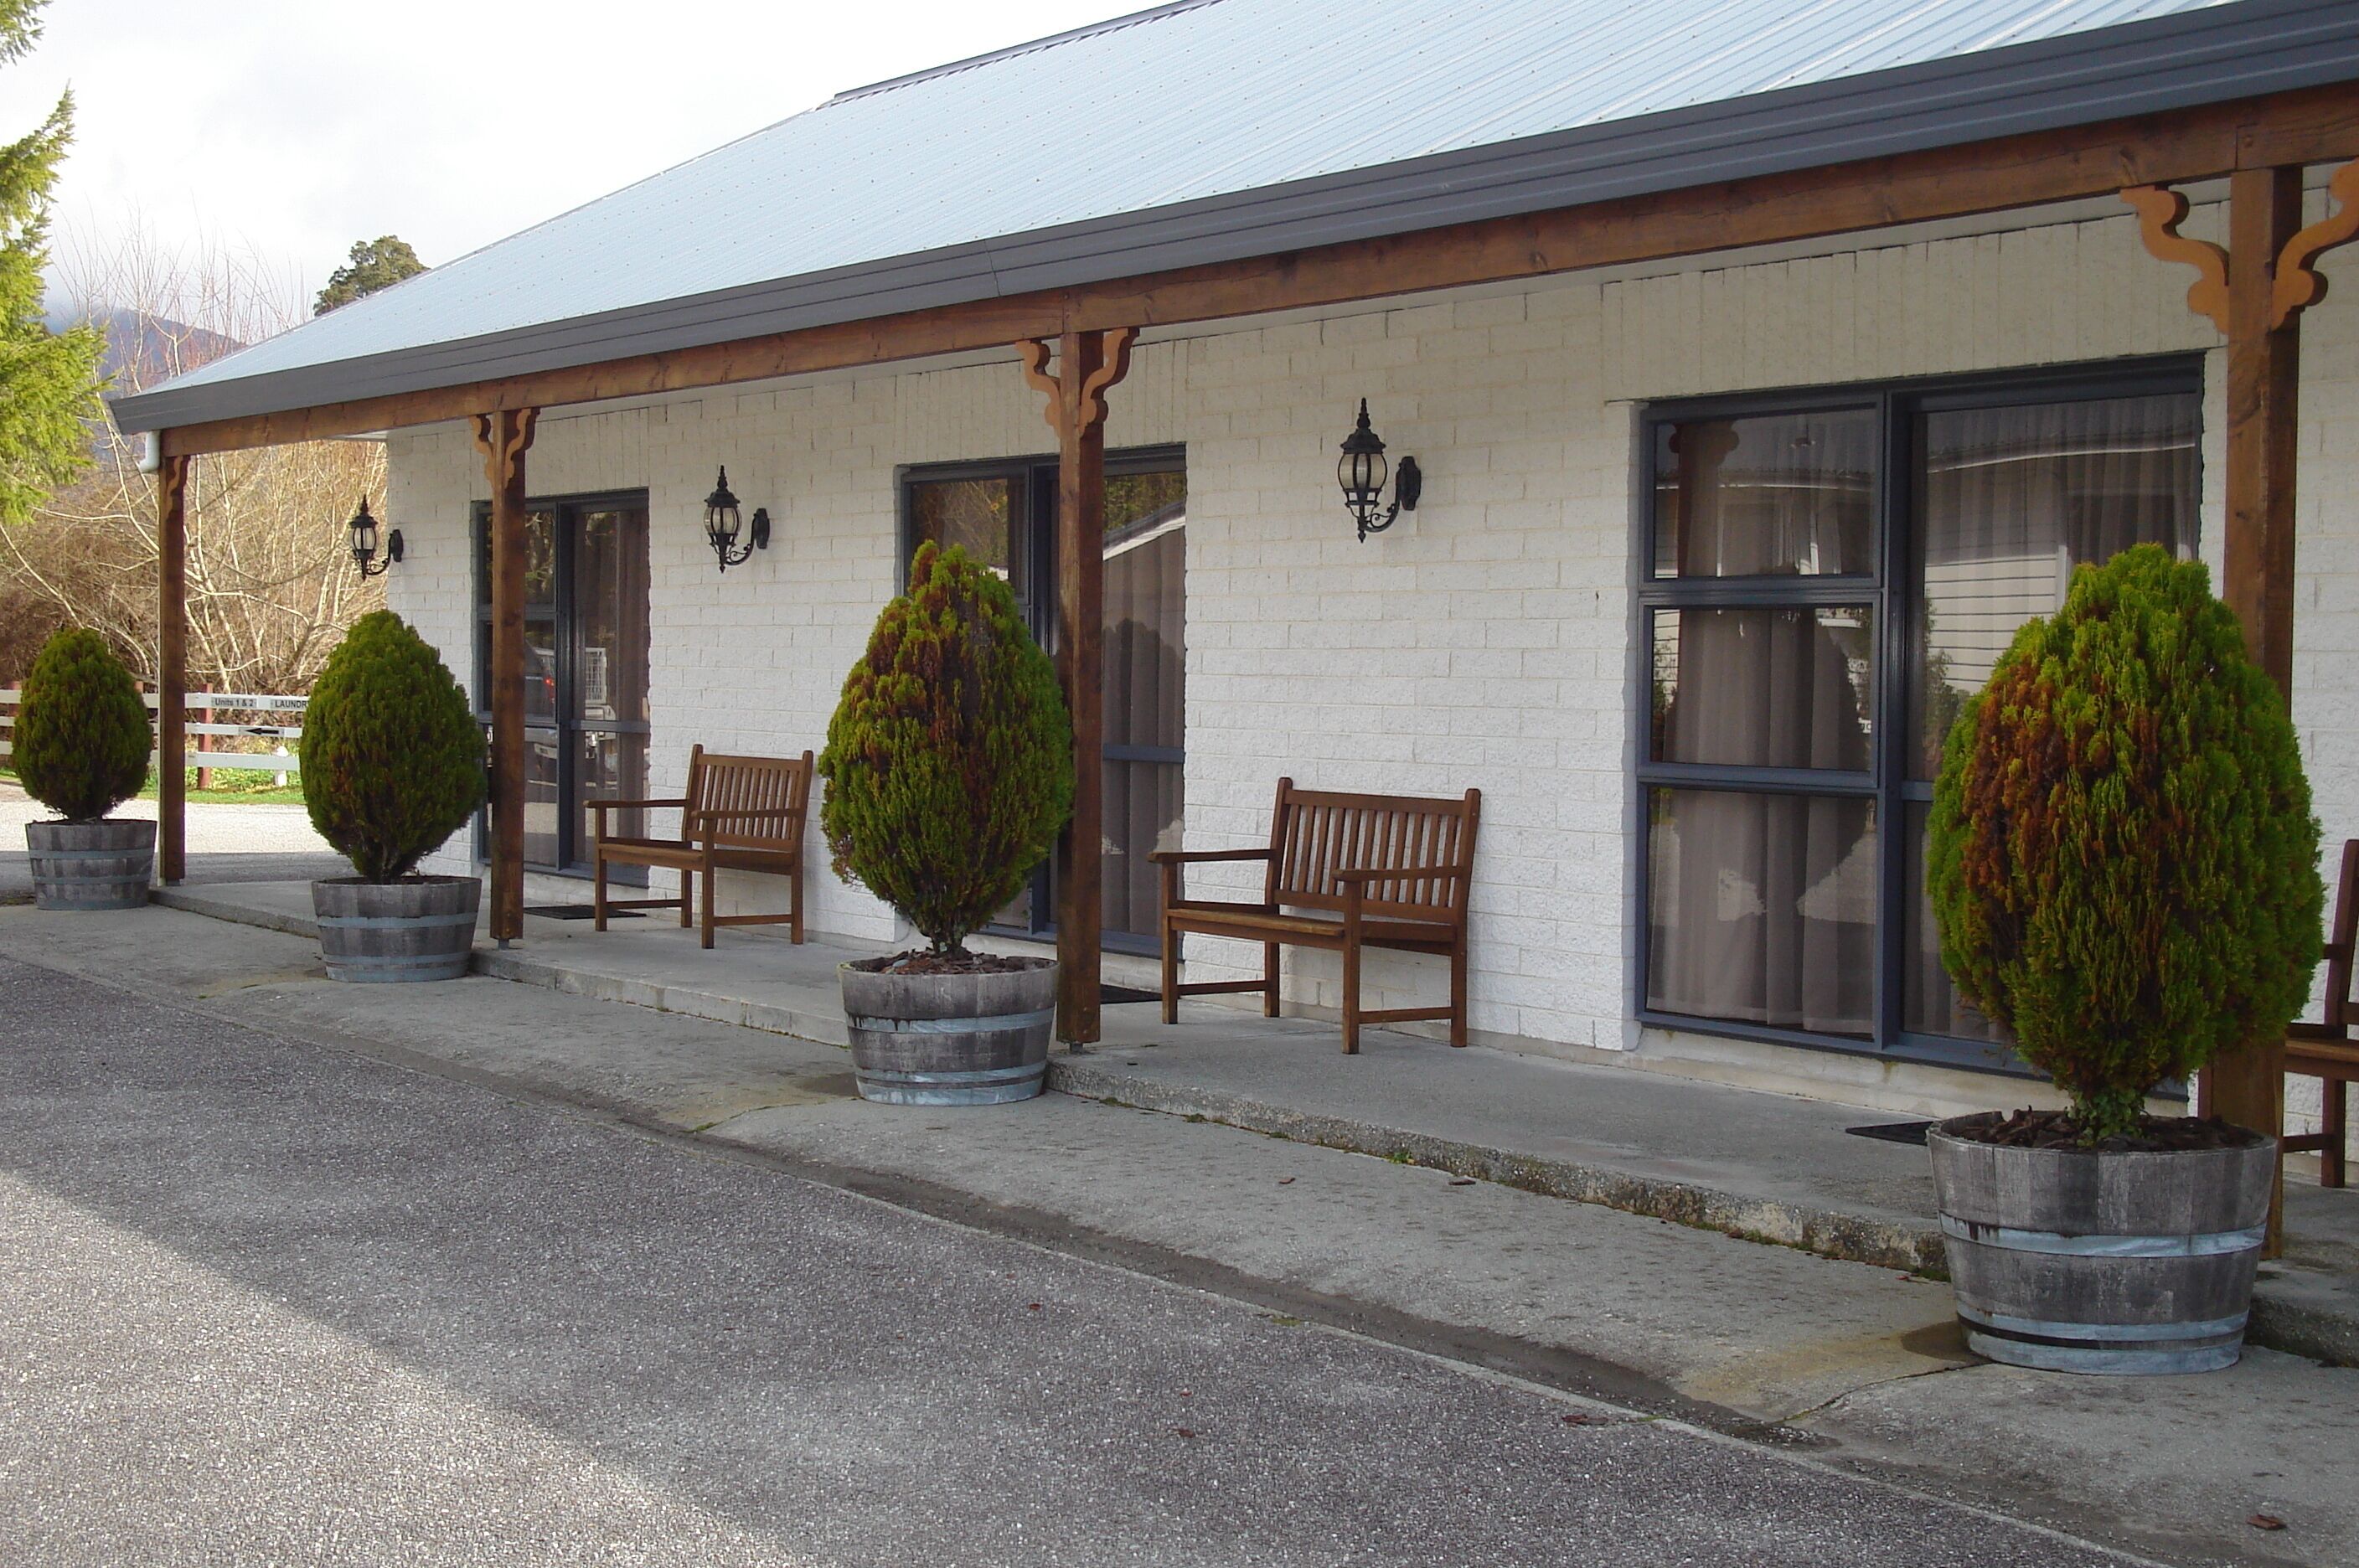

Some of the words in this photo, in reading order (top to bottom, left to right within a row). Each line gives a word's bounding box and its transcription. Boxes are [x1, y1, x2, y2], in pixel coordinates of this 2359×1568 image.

[214, 698, 234, 706] Units
[241, 699, 247, 707] &
[249, 699, 254, 707] 2
